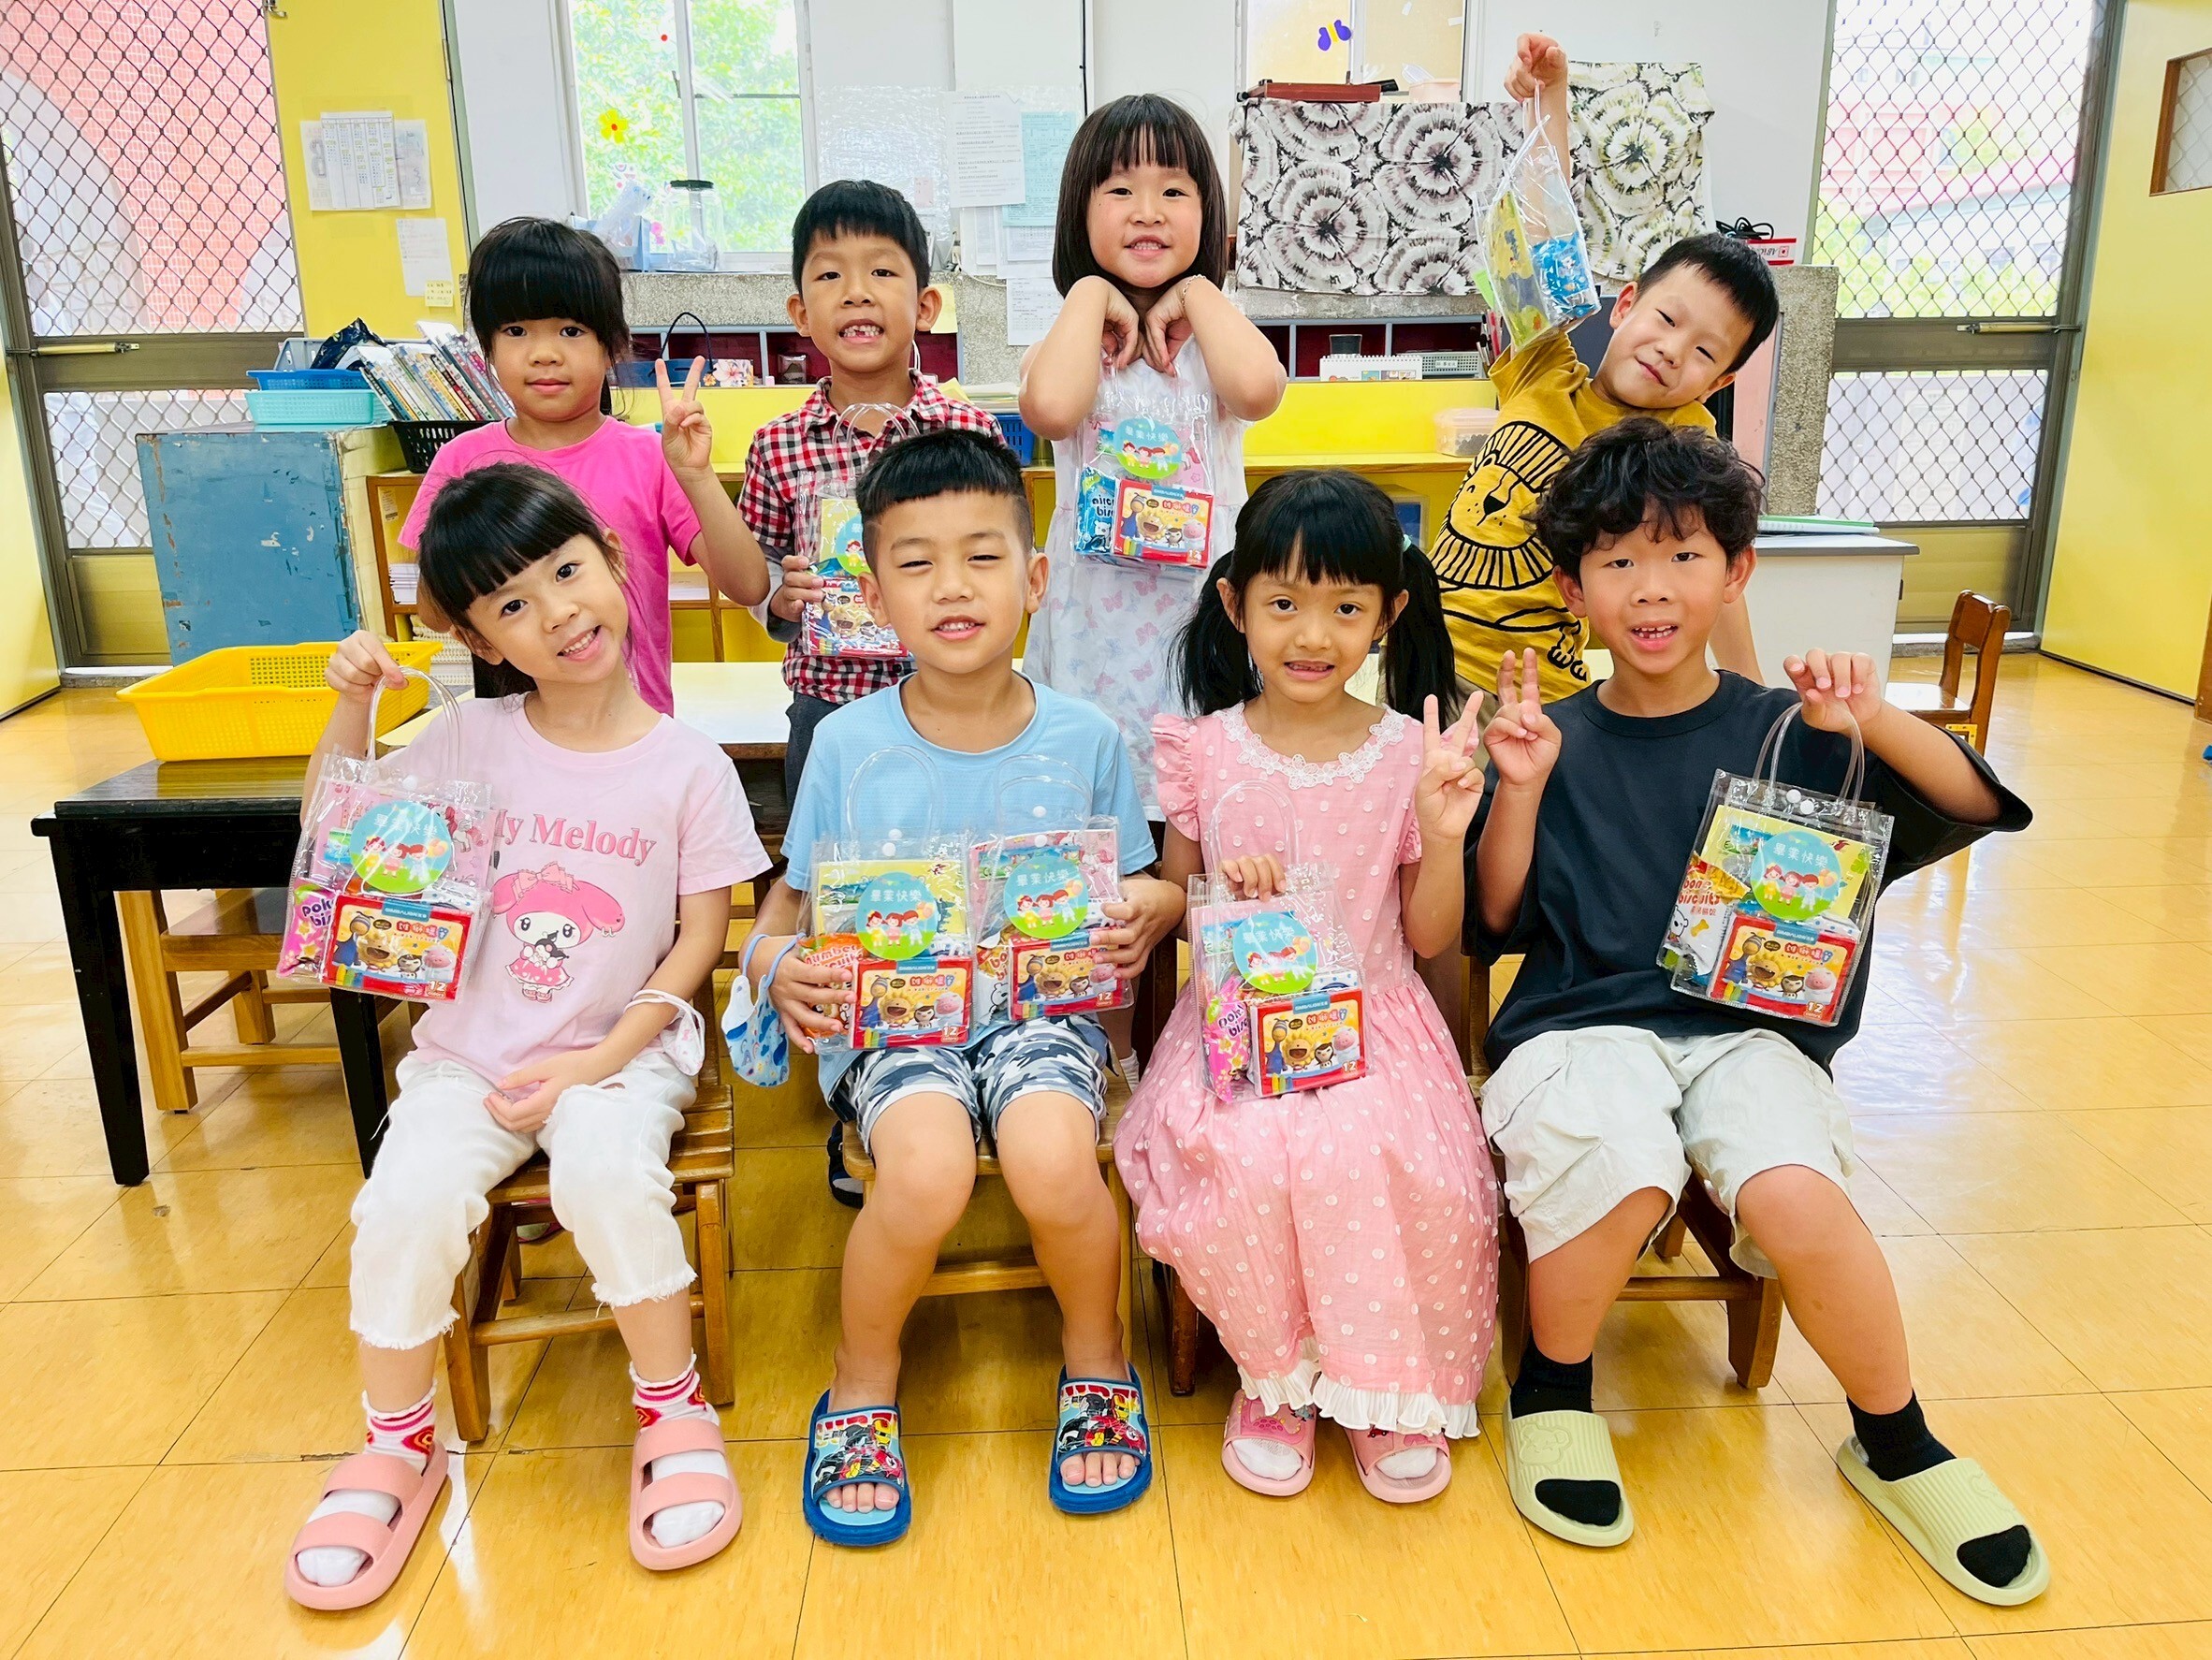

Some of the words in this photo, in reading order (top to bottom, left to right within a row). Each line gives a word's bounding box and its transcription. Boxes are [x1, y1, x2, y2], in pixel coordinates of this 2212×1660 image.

[529, 813, 657, 866] Melody
[1772, 842, 1828, 868] 畢業快樂
[1015, 868, 1070, 887] 畢業快樂
[870, 889, 923, 903] 畢業快樂
[429, 980, 446, 992] 12
[1098, 992, 1113, 1002] 12
[1808, 1001, 1824, 1013] 12
[942, 1026, 958, 1036] 12
[1342, 1060, 1357, 1072] 12
